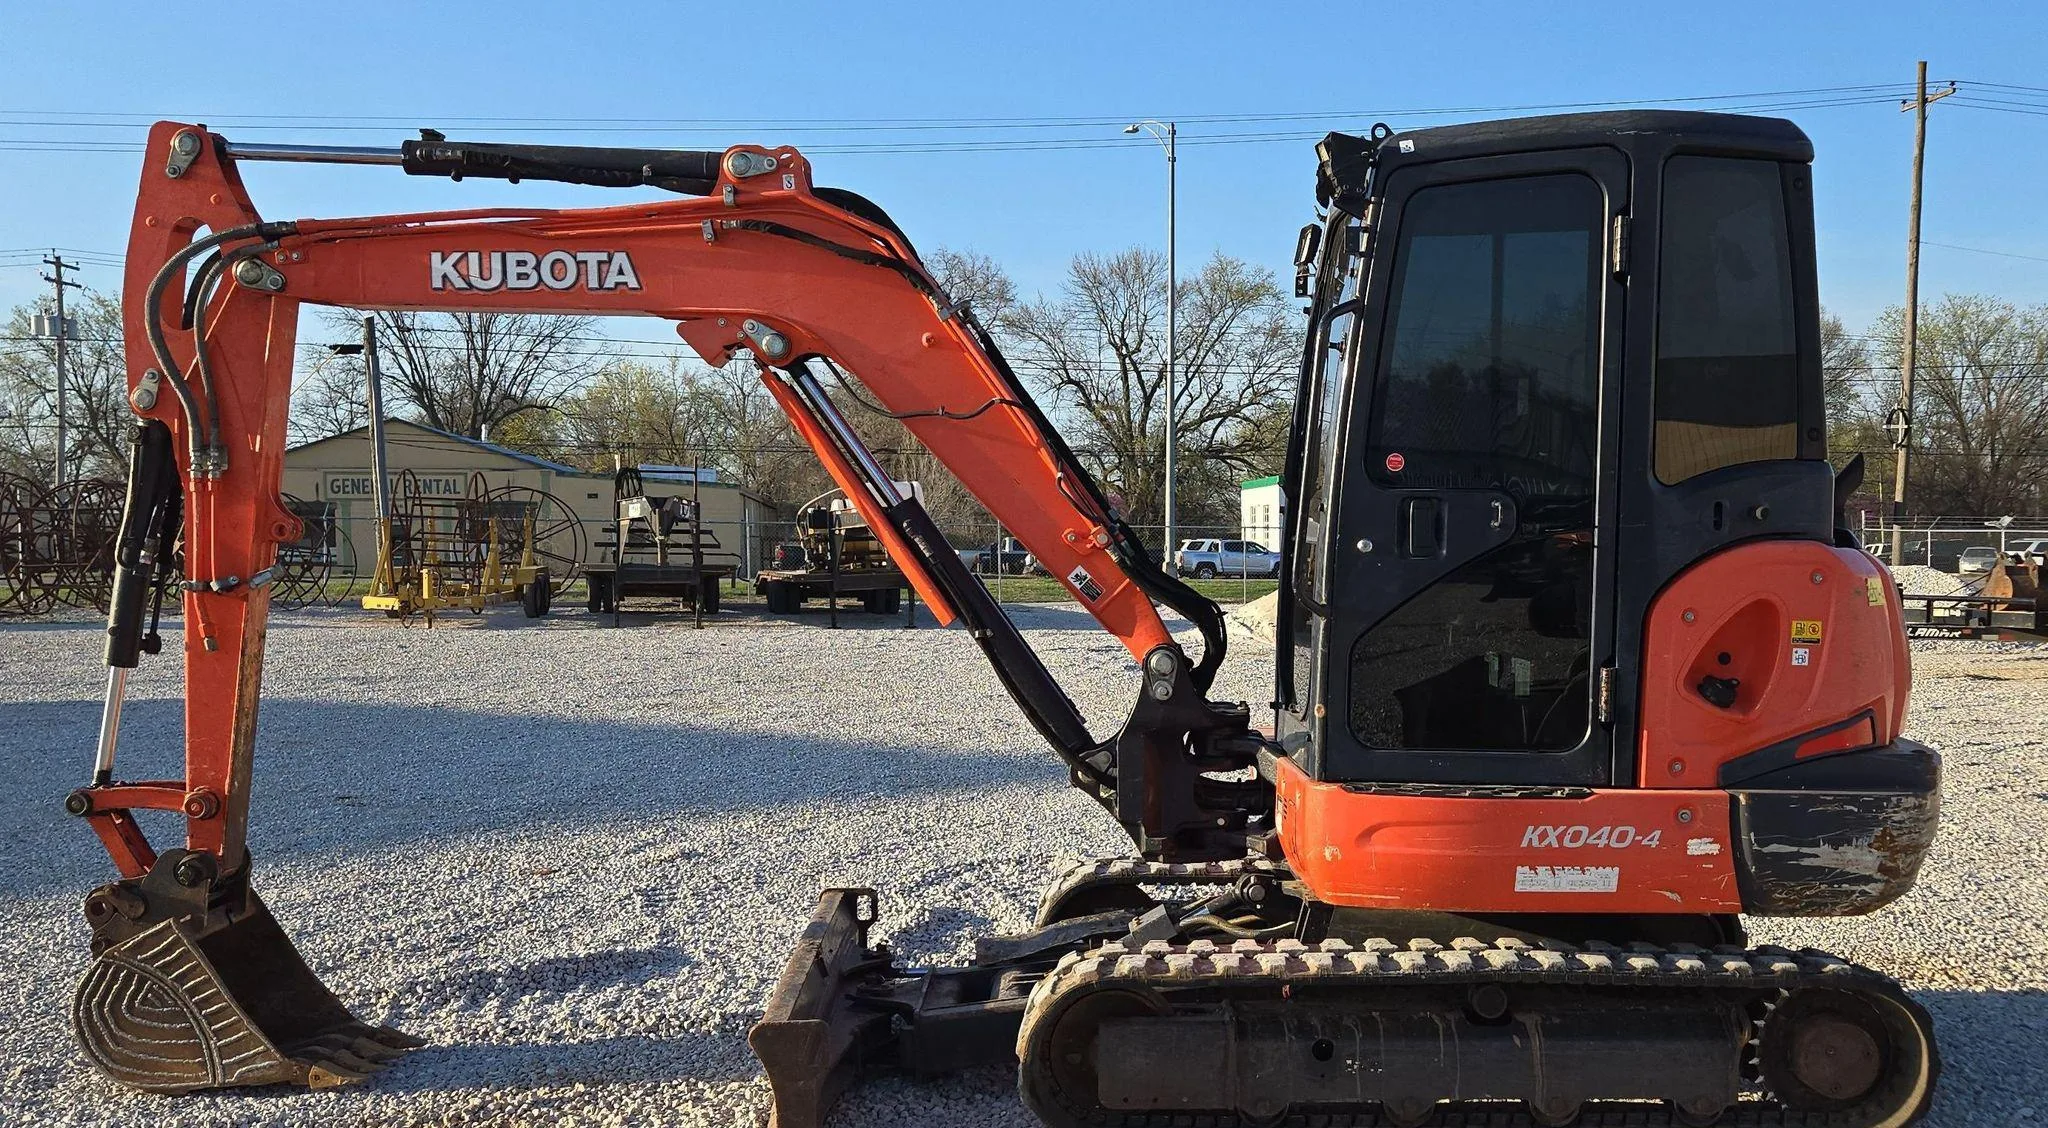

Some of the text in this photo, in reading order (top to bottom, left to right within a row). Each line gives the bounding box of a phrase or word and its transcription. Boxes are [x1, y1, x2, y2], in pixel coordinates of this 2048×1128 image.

[430, 251, 642, 290] KUBOTA
[330, 478, 398, 494] GENEL
[1521, 825, 1662, 848] KX040-4
